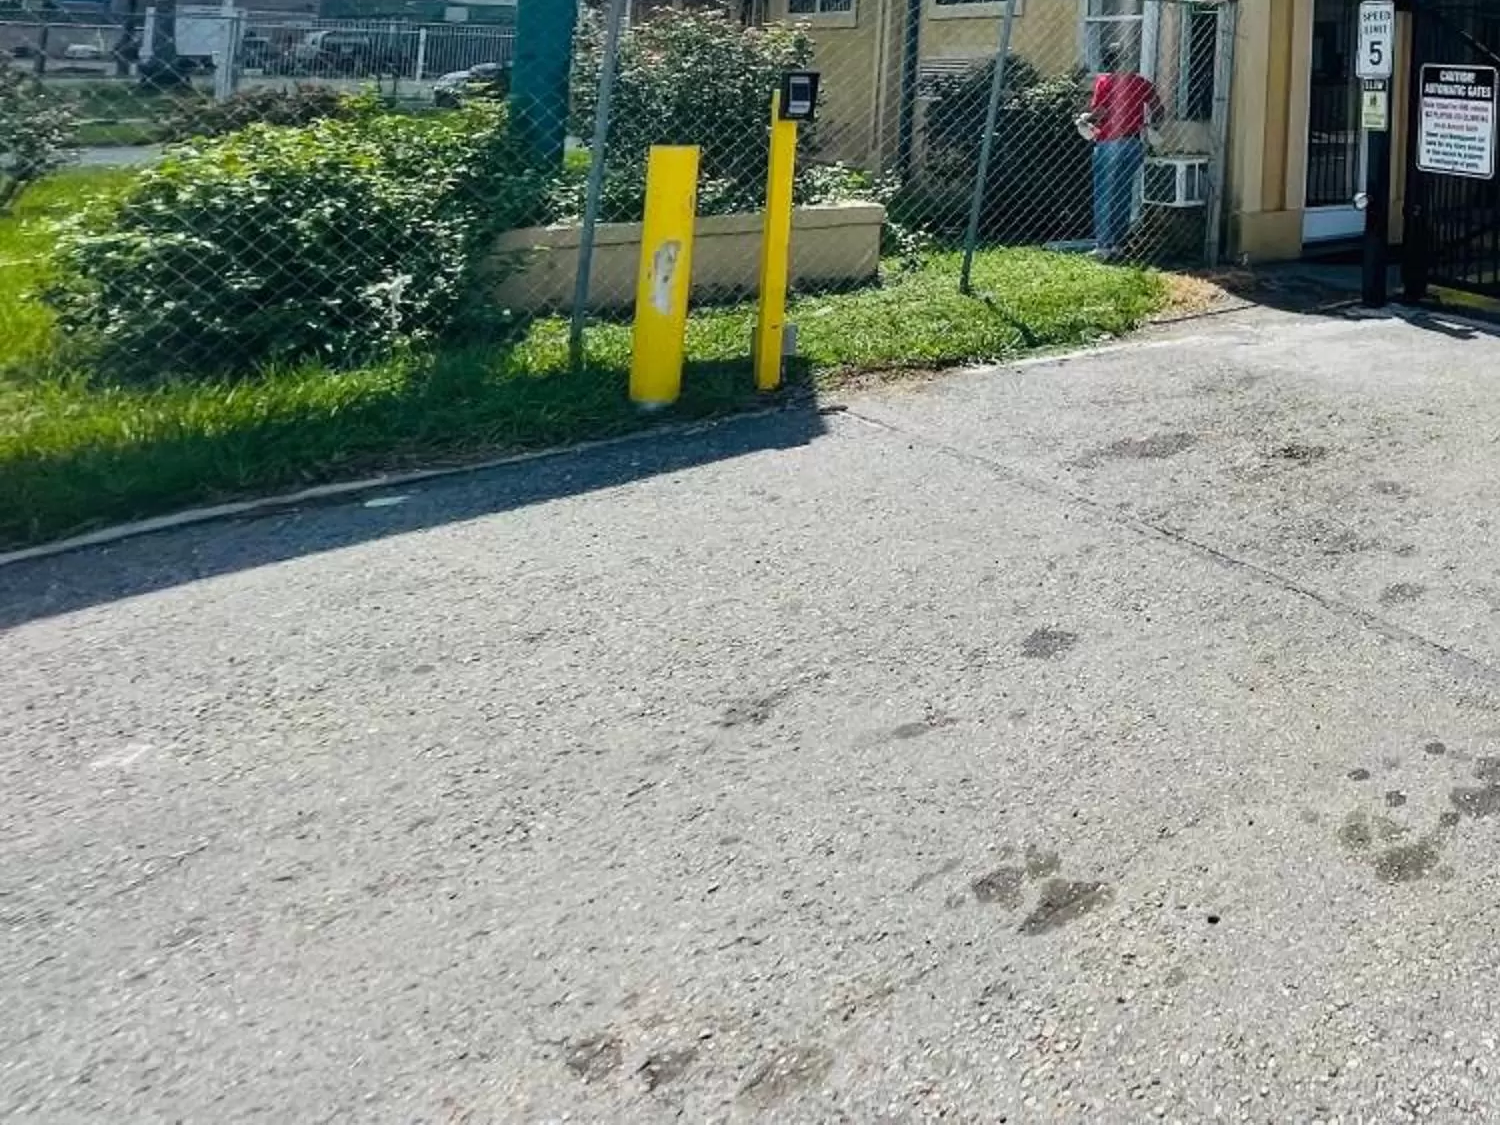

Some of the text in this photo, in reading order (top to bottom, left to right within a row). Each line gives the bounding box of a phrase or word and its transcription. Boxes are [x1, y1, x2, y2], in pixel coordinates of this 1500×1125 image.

[1363, 10, 1391, 22] SPEED
[1364, 24, 1387, 35] LIMIT
[1369, 40, 1383, 65] 5
